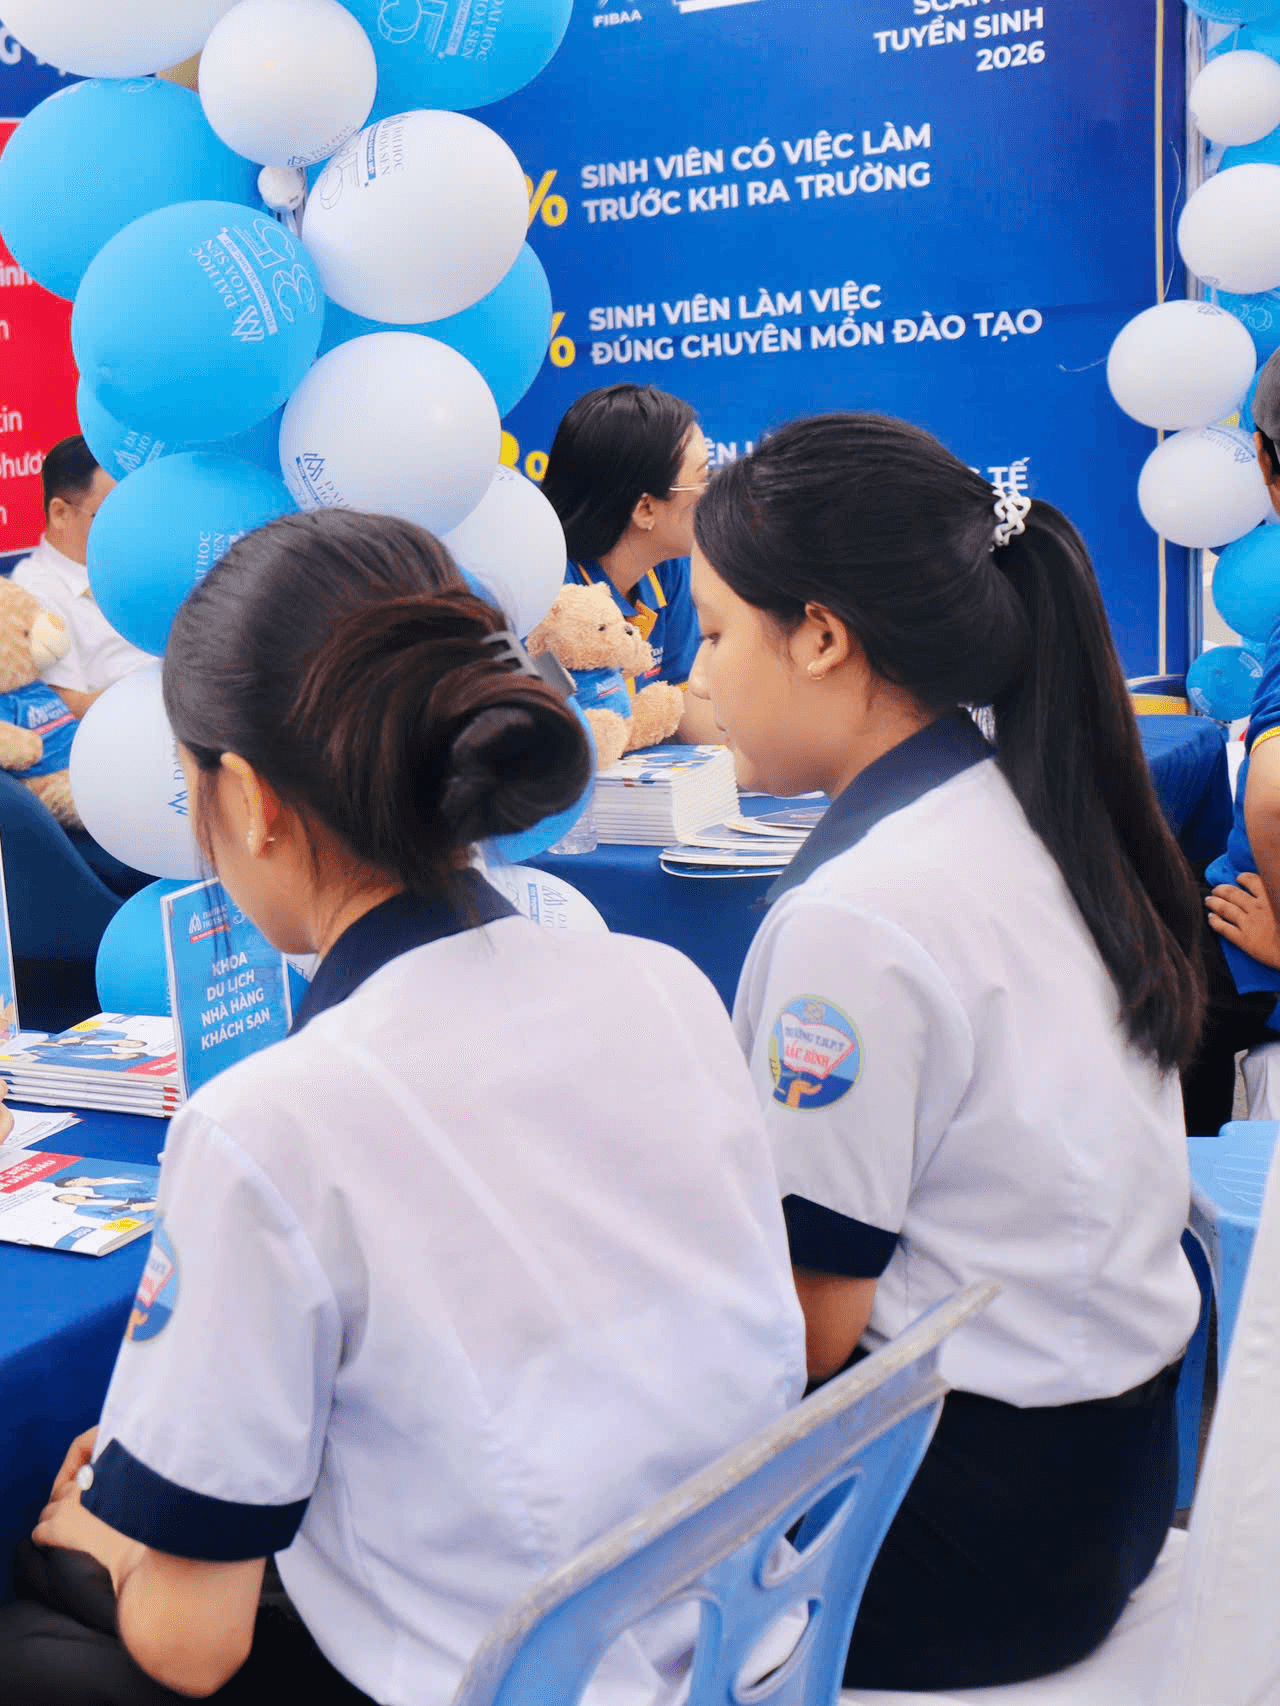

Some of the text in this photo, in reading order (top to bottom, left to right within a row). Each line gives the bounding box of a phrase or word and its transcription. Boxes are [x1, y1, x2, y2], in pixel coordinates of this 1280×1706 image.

[592, 9, 643, 28] FIBAA
[873, 6, 1045, 54] TUYỂN SINH
[975, 41, 1046, 72] 2026
[580, 122, 932, 190] SINH VIÊN CÓ VIỆC LÀM
[582, 156, 931, 225] TRƯỚC KHI RA TRƯỜNG
[588, 280, 881, 334] SINH VIÊN LÀM VIỆC
[590, 308, 1043, 367] ĐÚNG CHUYÊN MÔN ĐÀO TẠO
[206, 968, 255, 1003] DU LỊCH
[211, 951, 248, 977] KHOA
[201, 986, 265, 1027] NHÀ HÀNG
[201, 1007, 271, 1051] KHÁCH SẠN
